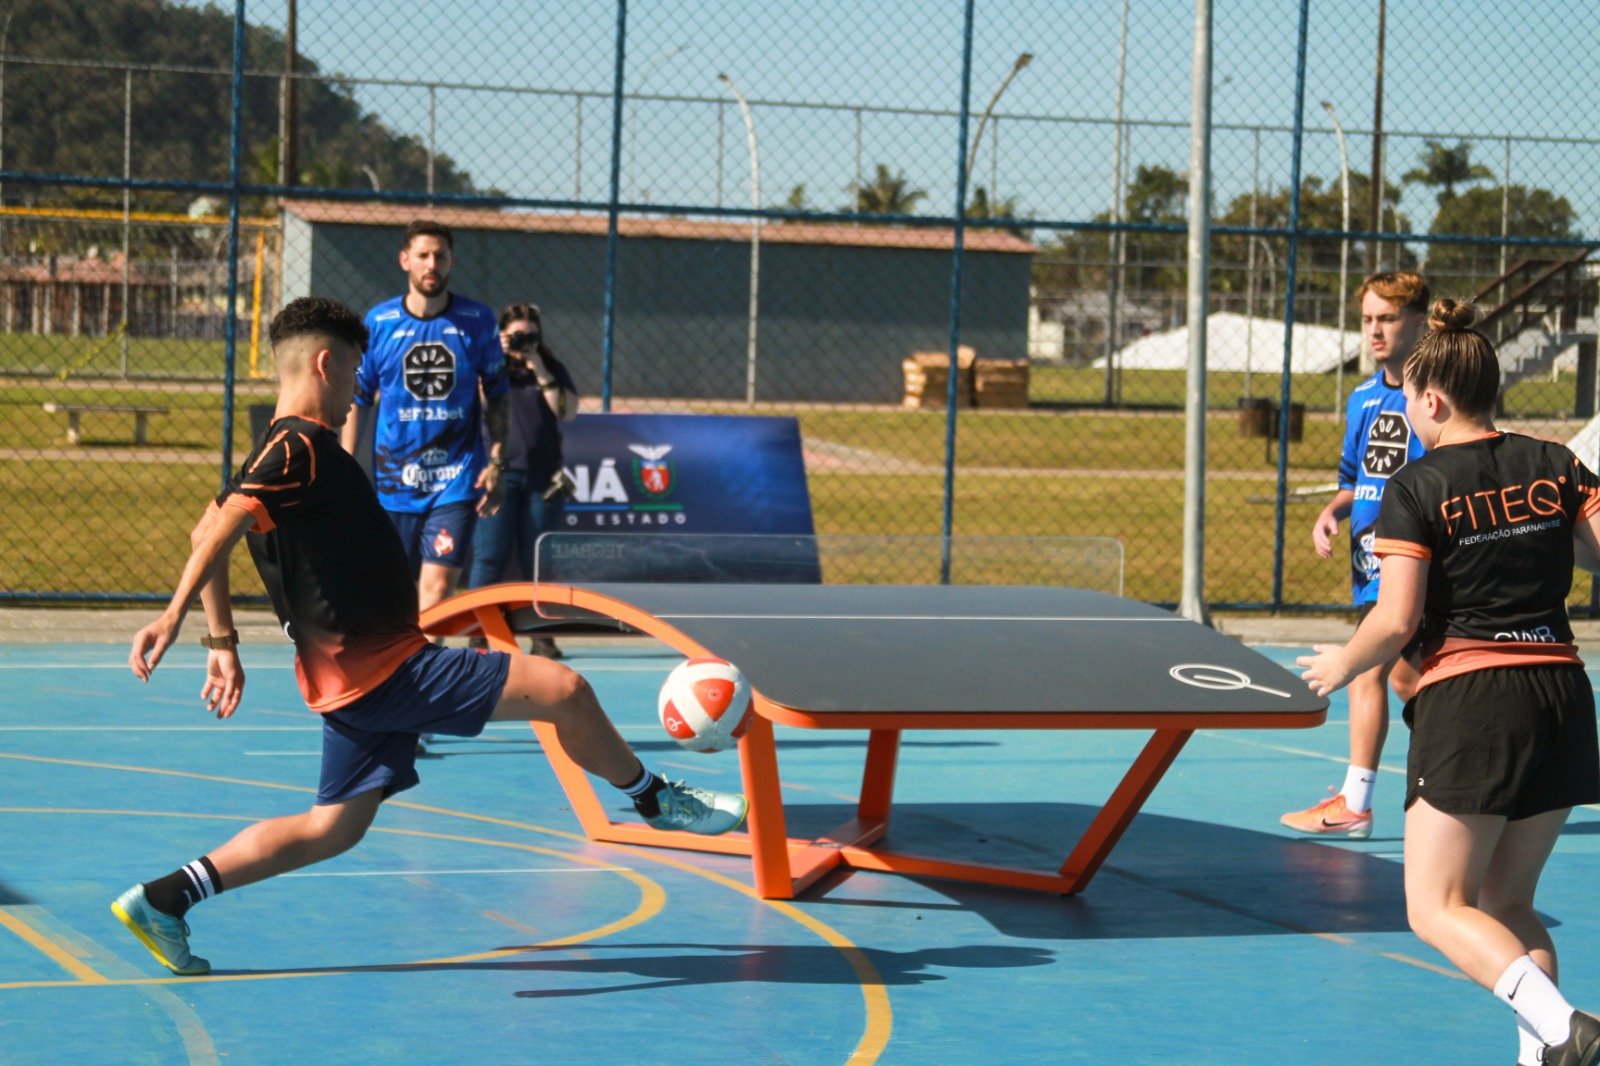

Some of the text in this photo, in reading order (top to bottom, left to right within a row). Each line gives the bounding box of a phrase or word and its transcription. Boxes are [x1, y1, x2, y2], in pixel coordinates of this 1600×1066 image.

[1371, 417, 1402, 439] FOOT
[566, 512, 687, 526] O ESTADO
[1440, 478, 1567, 536] FITEQ
[1458, 518, 1561, 546] FEDERAÇÃO PARANAENSE
